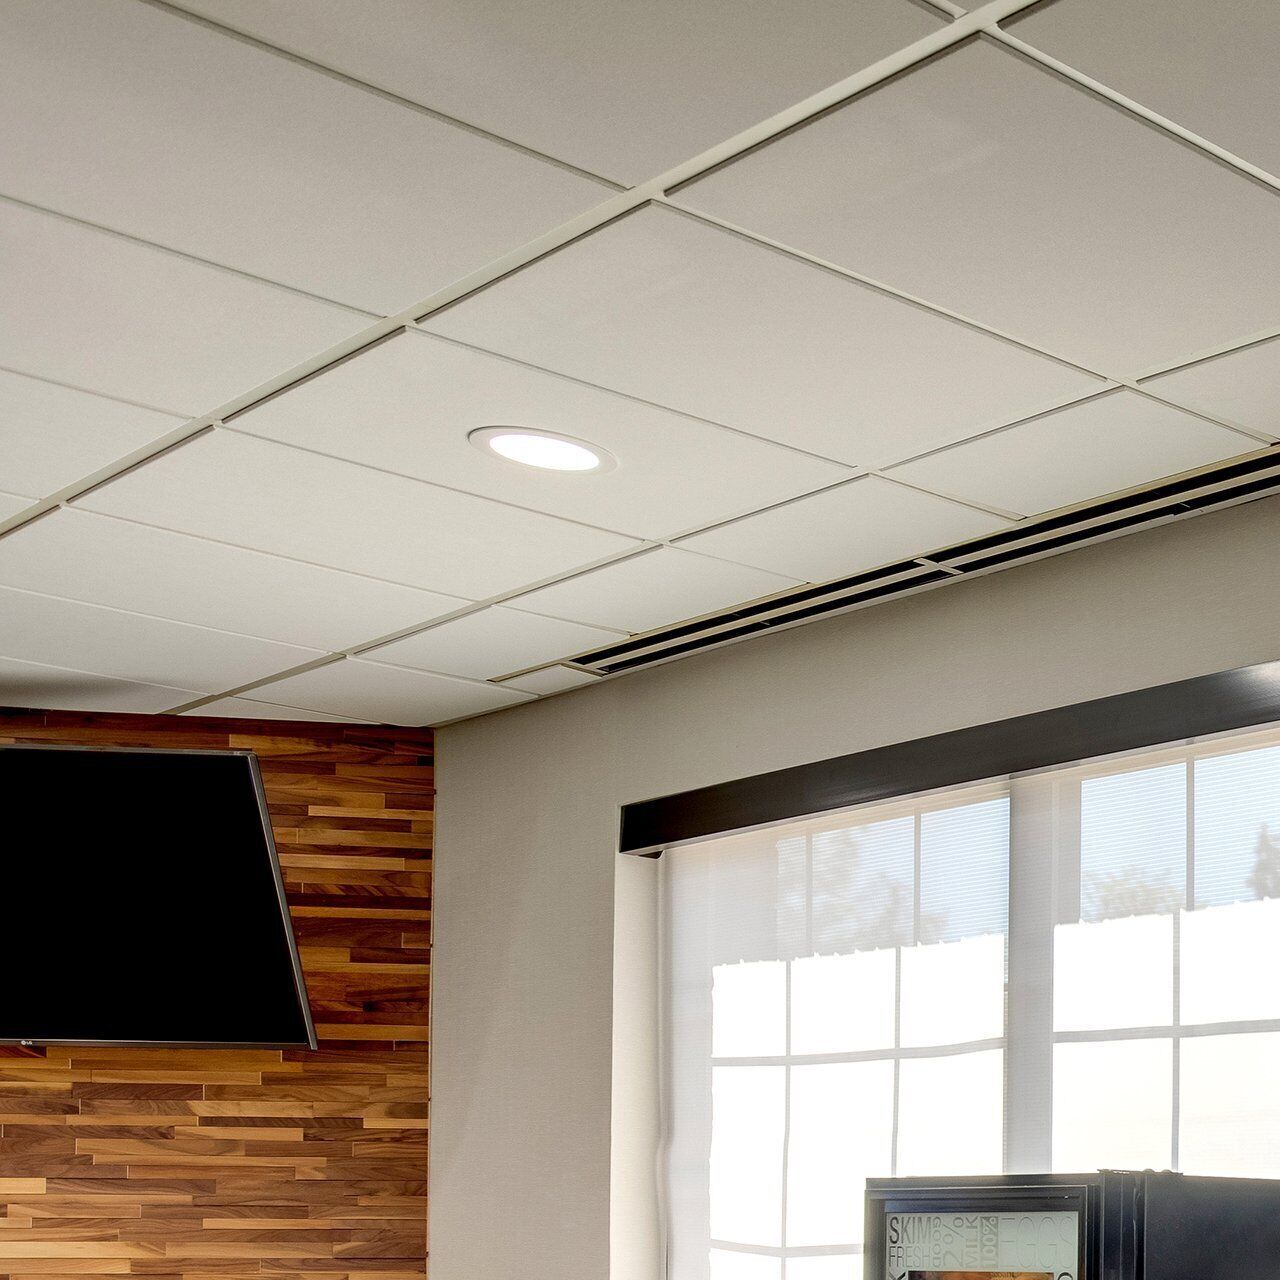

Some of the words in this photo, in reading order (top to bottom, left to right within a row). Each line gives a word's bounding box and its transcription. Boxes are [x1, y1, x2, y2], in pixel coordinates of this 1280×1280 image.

[889, 1216, 931, 1245] SKIM
[965, 1215, 979, 1268] MILK
[1001, 1216, 1074, 1268] EGGS
[888, 1245, 932, 1268] FRESH
